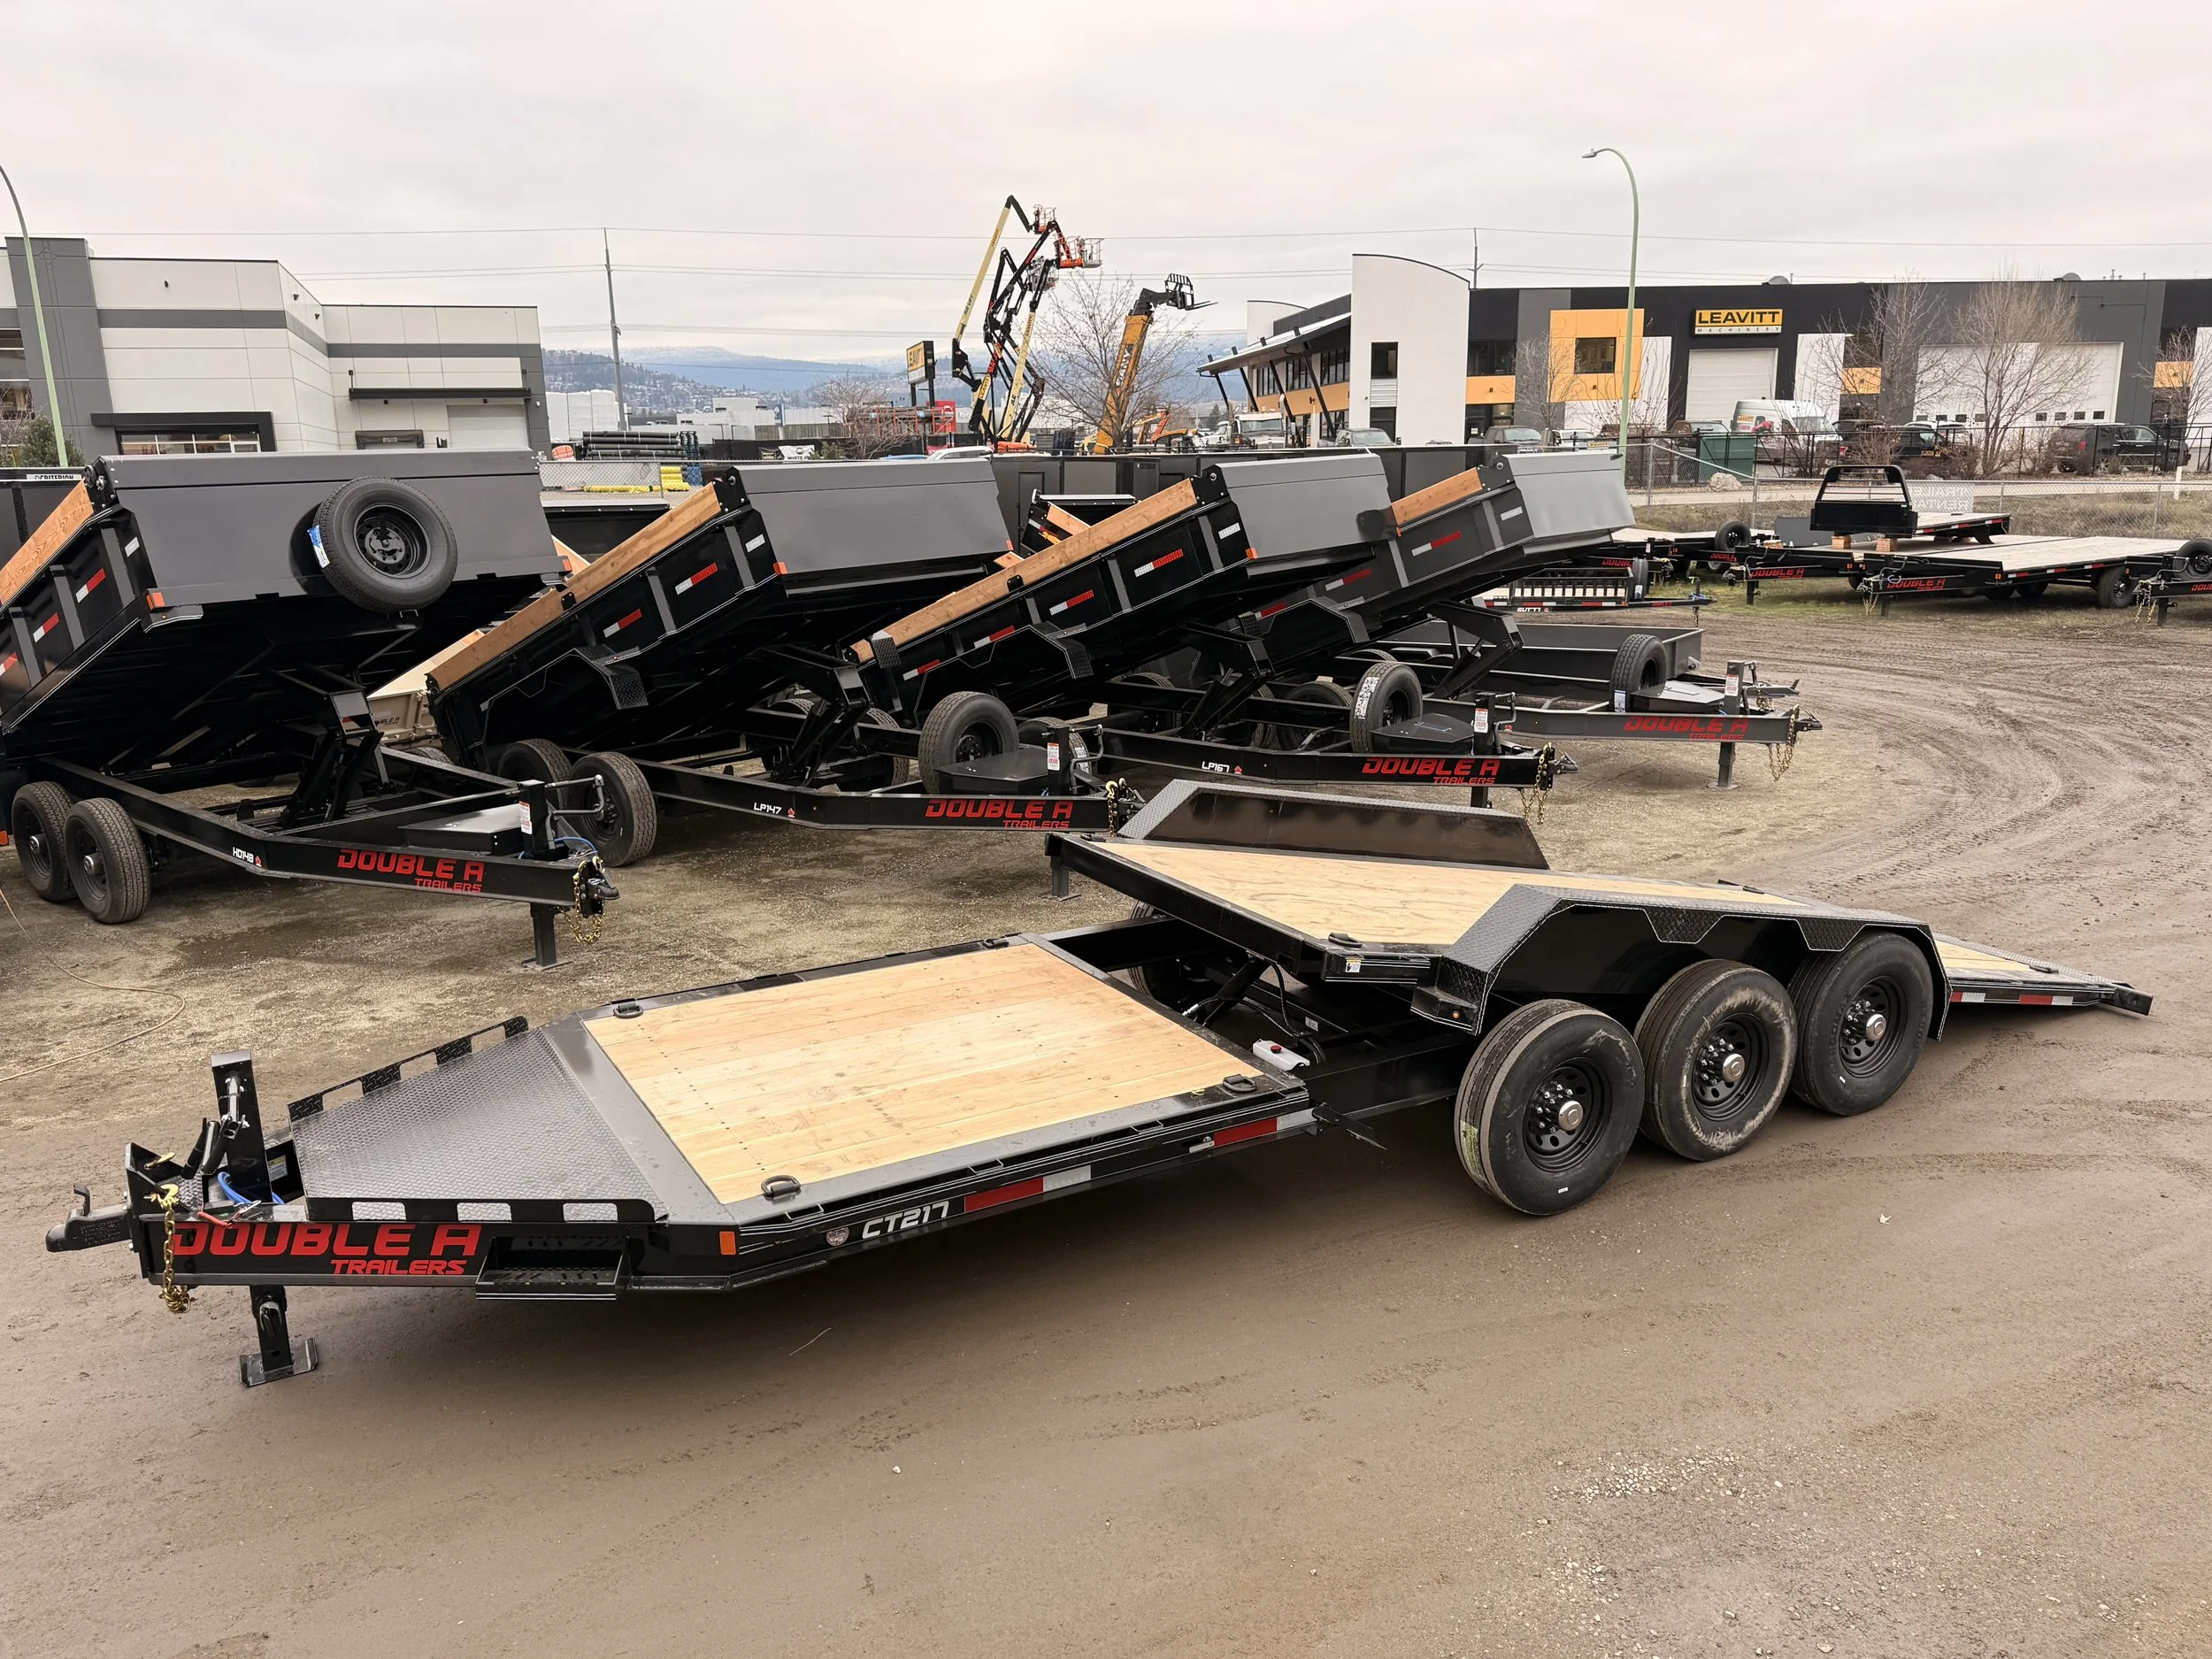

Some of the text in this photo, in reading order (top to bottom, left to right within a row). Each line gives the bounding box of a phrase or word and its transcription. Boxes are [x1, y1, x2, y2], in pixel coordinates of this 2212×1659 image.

[1698, 311, 1780, 324] LEAVITT
[1624, 716, 1749, 733] DOUBLE A
[1202, 761, 1230, 773] LP167
[1362, 757, 1501, 776] DOUBLE A
[753, 802, 782, 814] LP147
[926, 799, 1074, 819] DOUBLE A
[1002, 819, 1070, 829] TRAILERS
[232, 846, 254, 864] HD148
[337, 849, 485, 881] DOUBLE A
[414, 878, 482, 893] TRAILERS
[862, 1201, 949, 1239] CT217
[172, 1224, 482, 1256] DOUBLE A
[329, 1259, 467, 1274] TRAILERS
